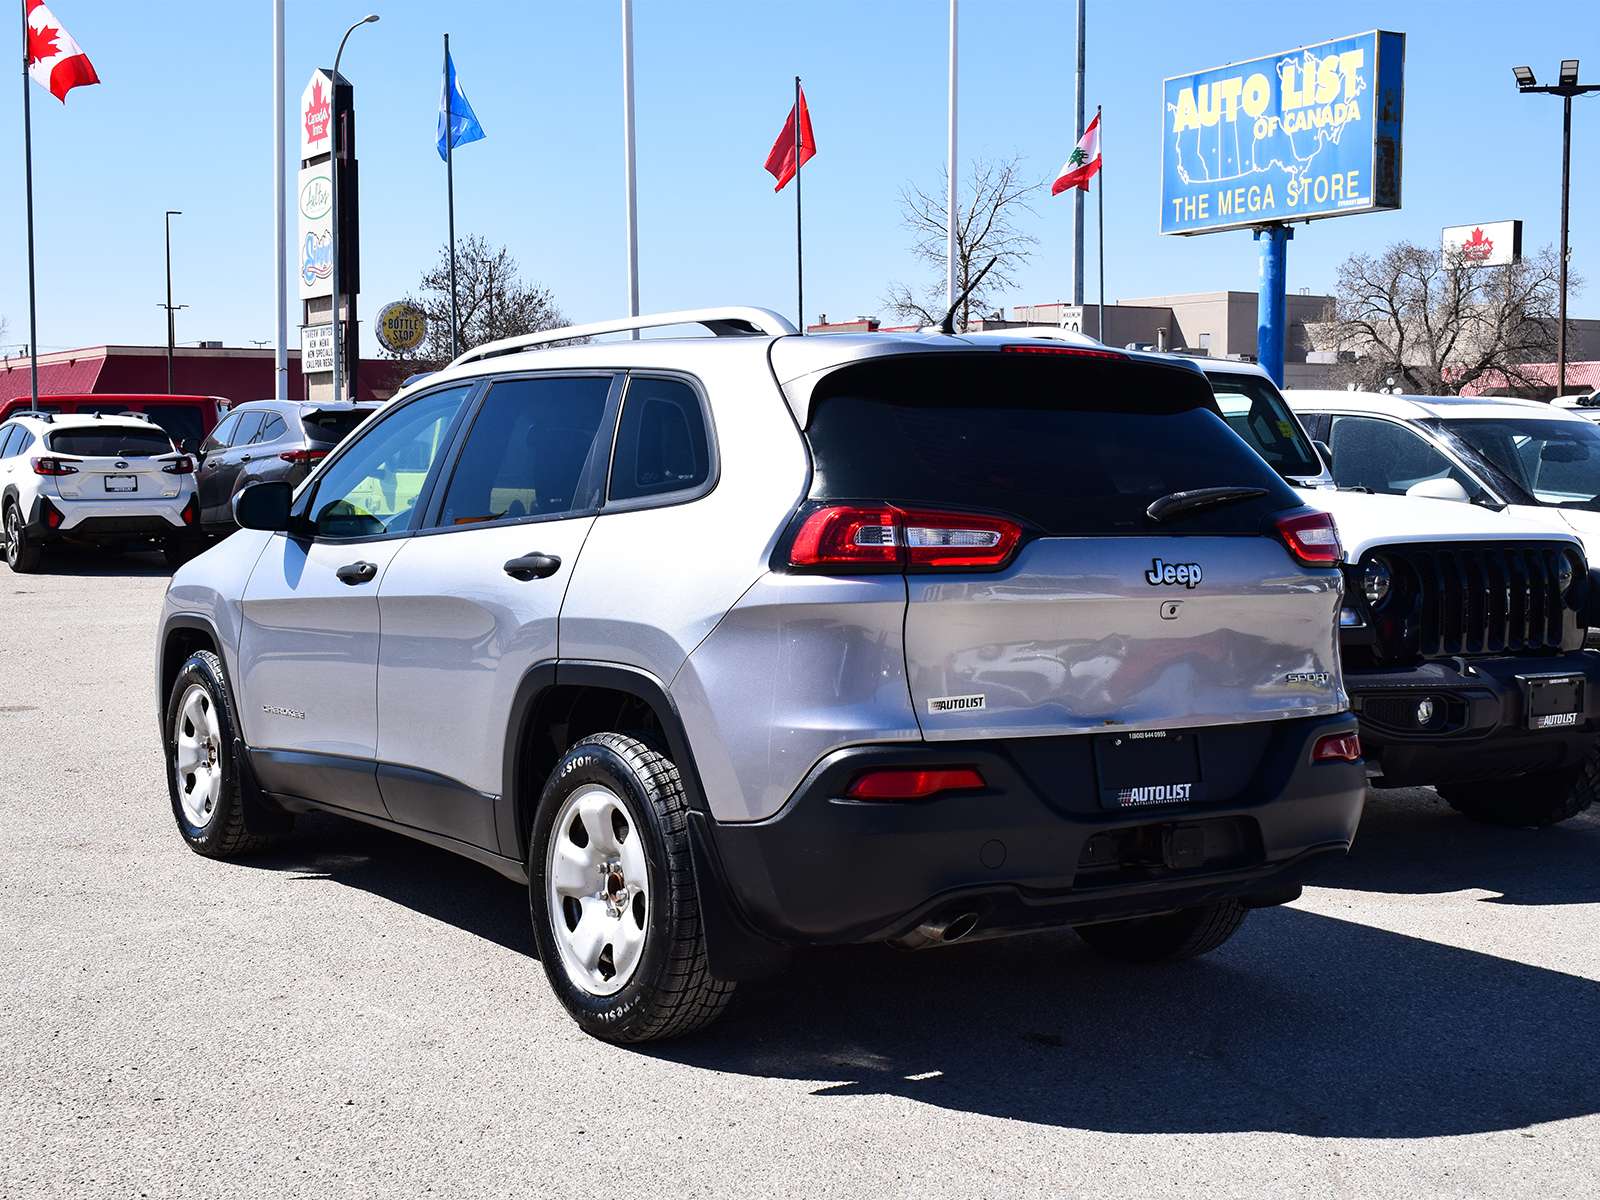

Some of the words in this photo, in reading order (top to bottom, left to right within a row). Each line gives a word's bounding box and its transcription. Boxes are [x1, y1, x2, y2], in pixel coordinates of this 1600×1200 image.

[1173, 73, 1271, 133] AUTO
[1281, 49, 1364, 111] LIST
[1253, 117, 1278, 139] OF
[1285, 100, 1361, 133] CANADA
[1172, 193, 1209, 222] THE
[1218, 184, 1275, 217] MEGA
[1287, 171, 1360, 207] STORE
[388, 318, 419, 331] BOTTLE
[393, 330, 414, 342] STOP
[1145, 558, 1202, 589] Jeep
[1286, 672, 1329, 683] SPORT
